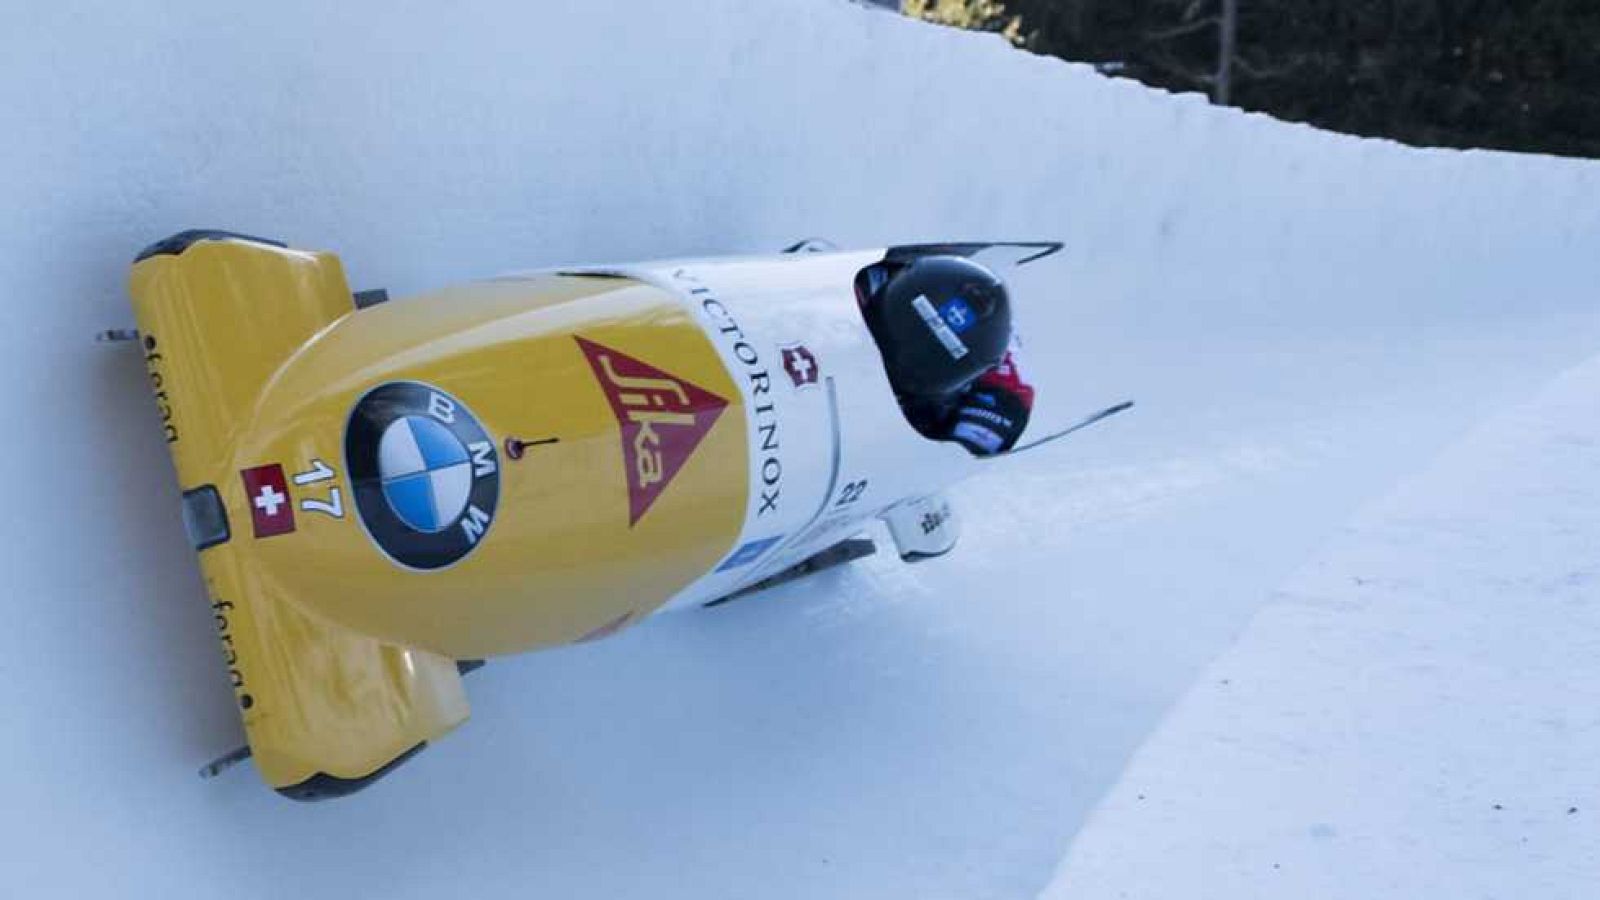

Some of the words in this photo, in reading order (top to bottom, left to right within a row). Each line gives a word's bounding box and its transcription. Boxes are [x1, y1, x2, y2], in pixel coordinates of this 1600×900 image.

[599, 354, 692, 488] Sika
[672, 267, 783, 517] VICTORINOX
[293, 458, 345, 519] 17
[428, 391, 497, 545] BMW
[835, 479, 868, 507] 22
